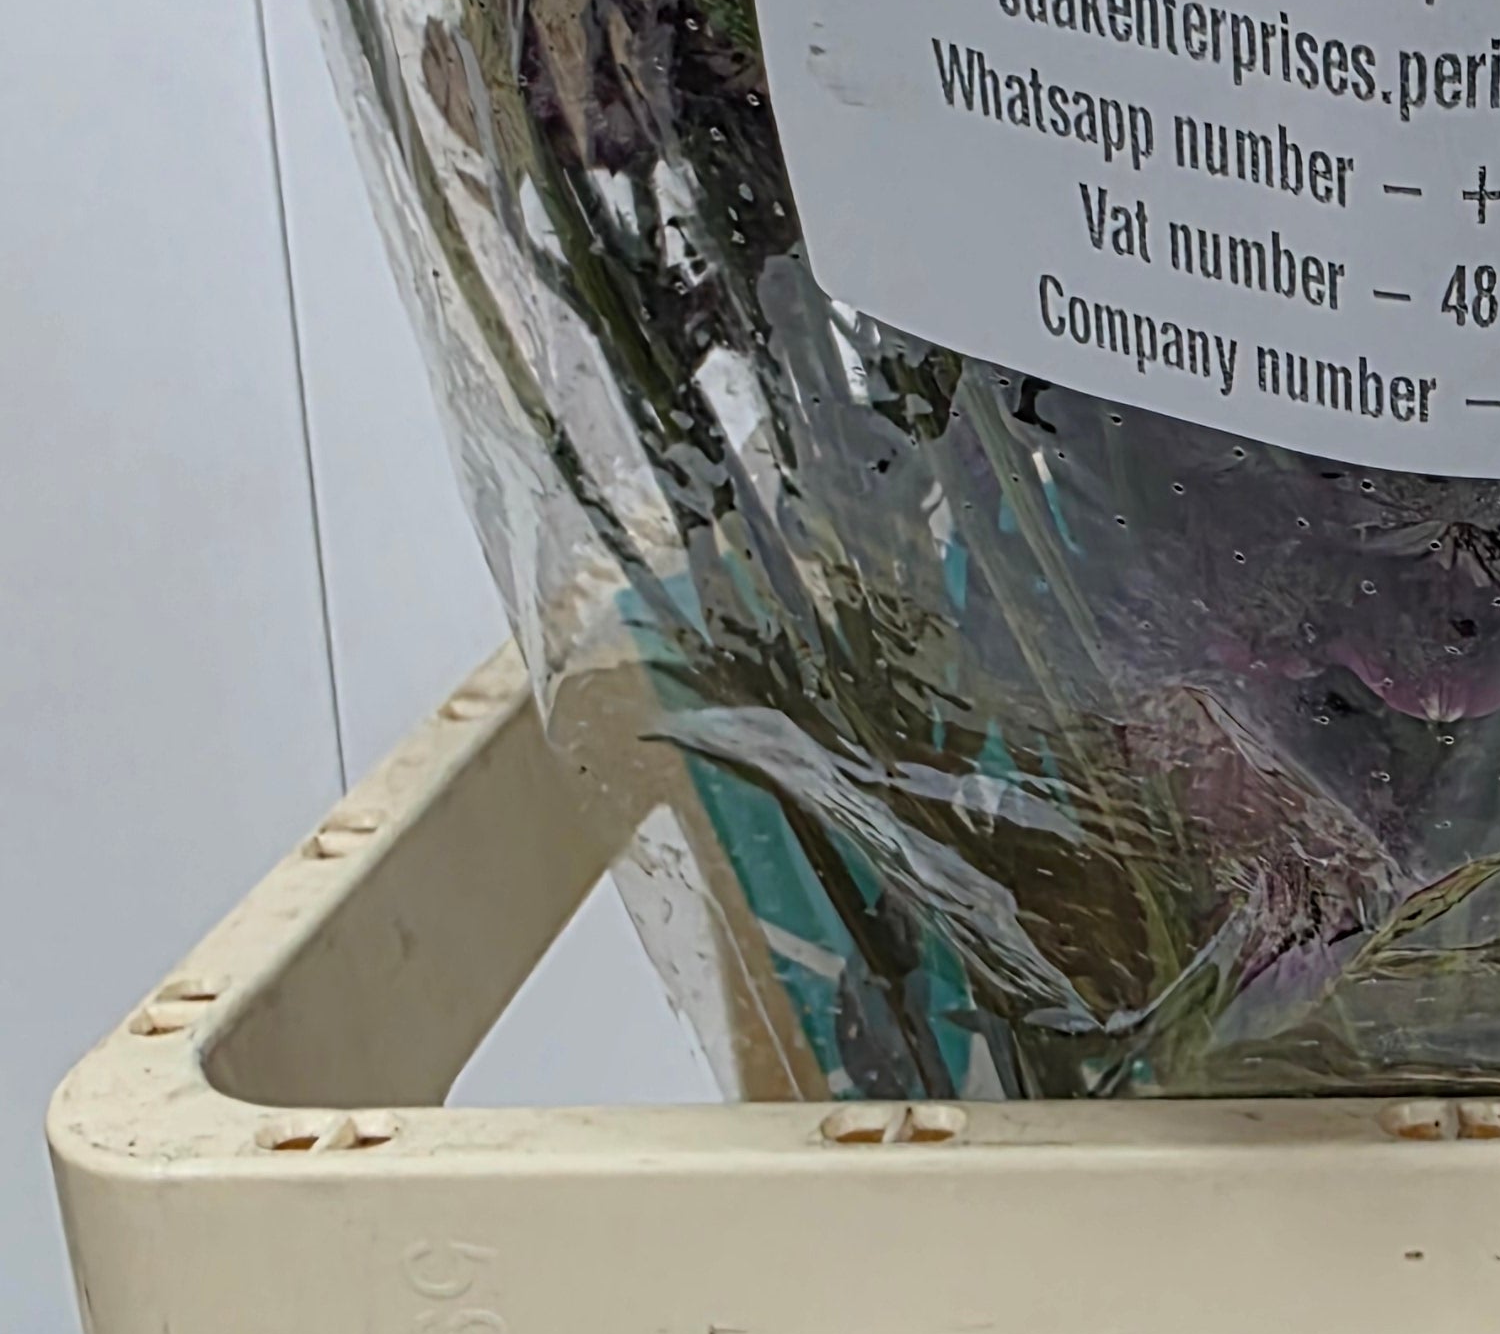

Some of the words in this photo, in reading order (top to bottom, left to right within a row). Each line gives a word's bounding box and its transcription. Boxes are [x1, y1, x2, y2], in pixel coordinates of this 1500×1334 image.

[932, 38, 1153, 171] Whatsapp
[1174, 116, 1353, 208] number
[1079, 182, 1151, 263] Vat
[1169, 222, 1344, 310] number
[1039, 275, 1237, 396] Company
[1257, 346, 1436, 422] number
